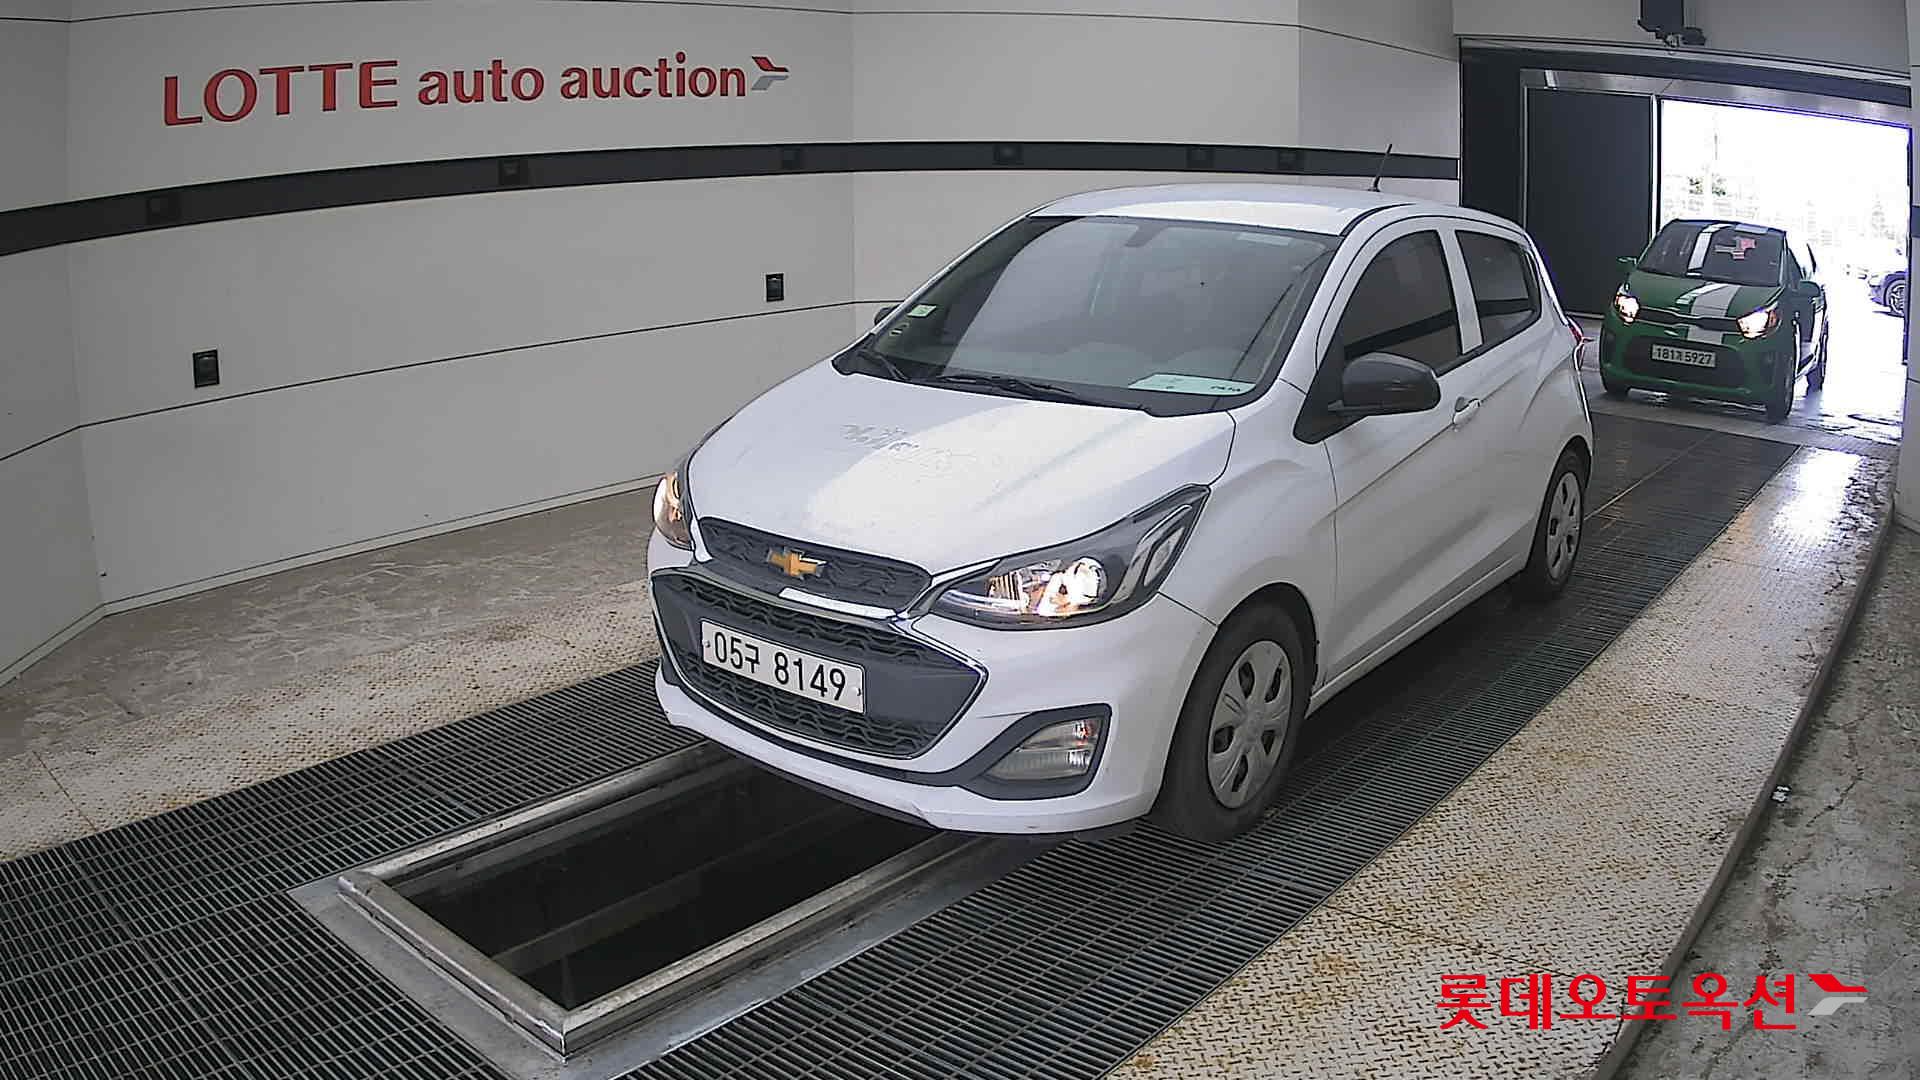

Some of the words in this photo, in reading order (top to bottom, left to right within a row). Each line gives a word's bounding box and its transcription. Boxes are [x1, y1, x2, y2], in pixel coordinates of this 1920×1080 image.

[164, 60, 398, 126] LOTTE
[417, 59, 545, 105] auto
[560, 51, 746, 99] auction
[1685, 351, 1712, 365] 5927
[714, 631, 760, 674] 05구
[774, 651, 846, 701] 8149
